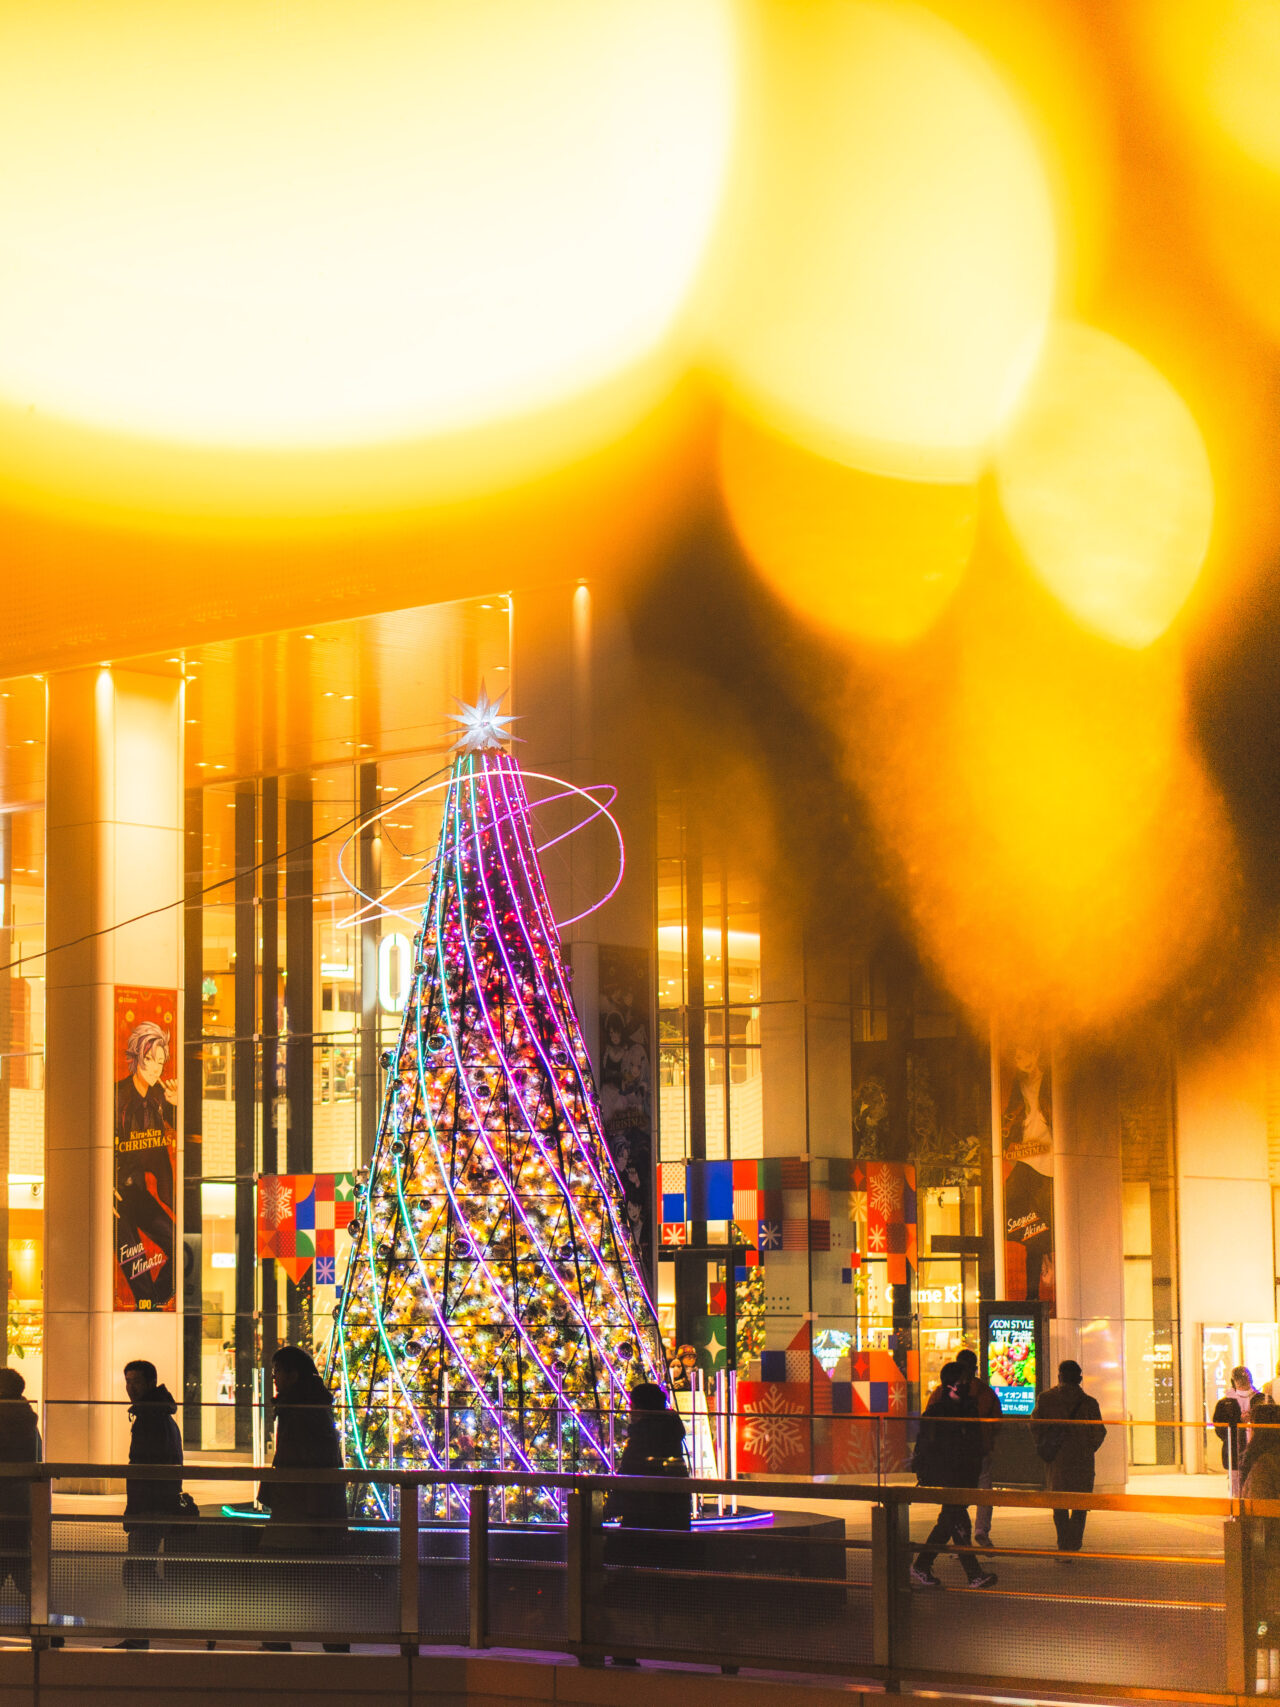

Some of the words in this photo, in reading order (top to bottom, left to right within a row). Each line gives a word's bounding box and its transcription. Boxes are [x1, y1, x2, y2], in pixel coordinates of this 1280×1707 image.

[119, 1134, 172, 1152] CHRISTMAS
[120, 1242, 145, 1264] Fuwa
[131, 1253, 164, 1278] Minato
[1011, 1319, 1035, 1329] STYLE
